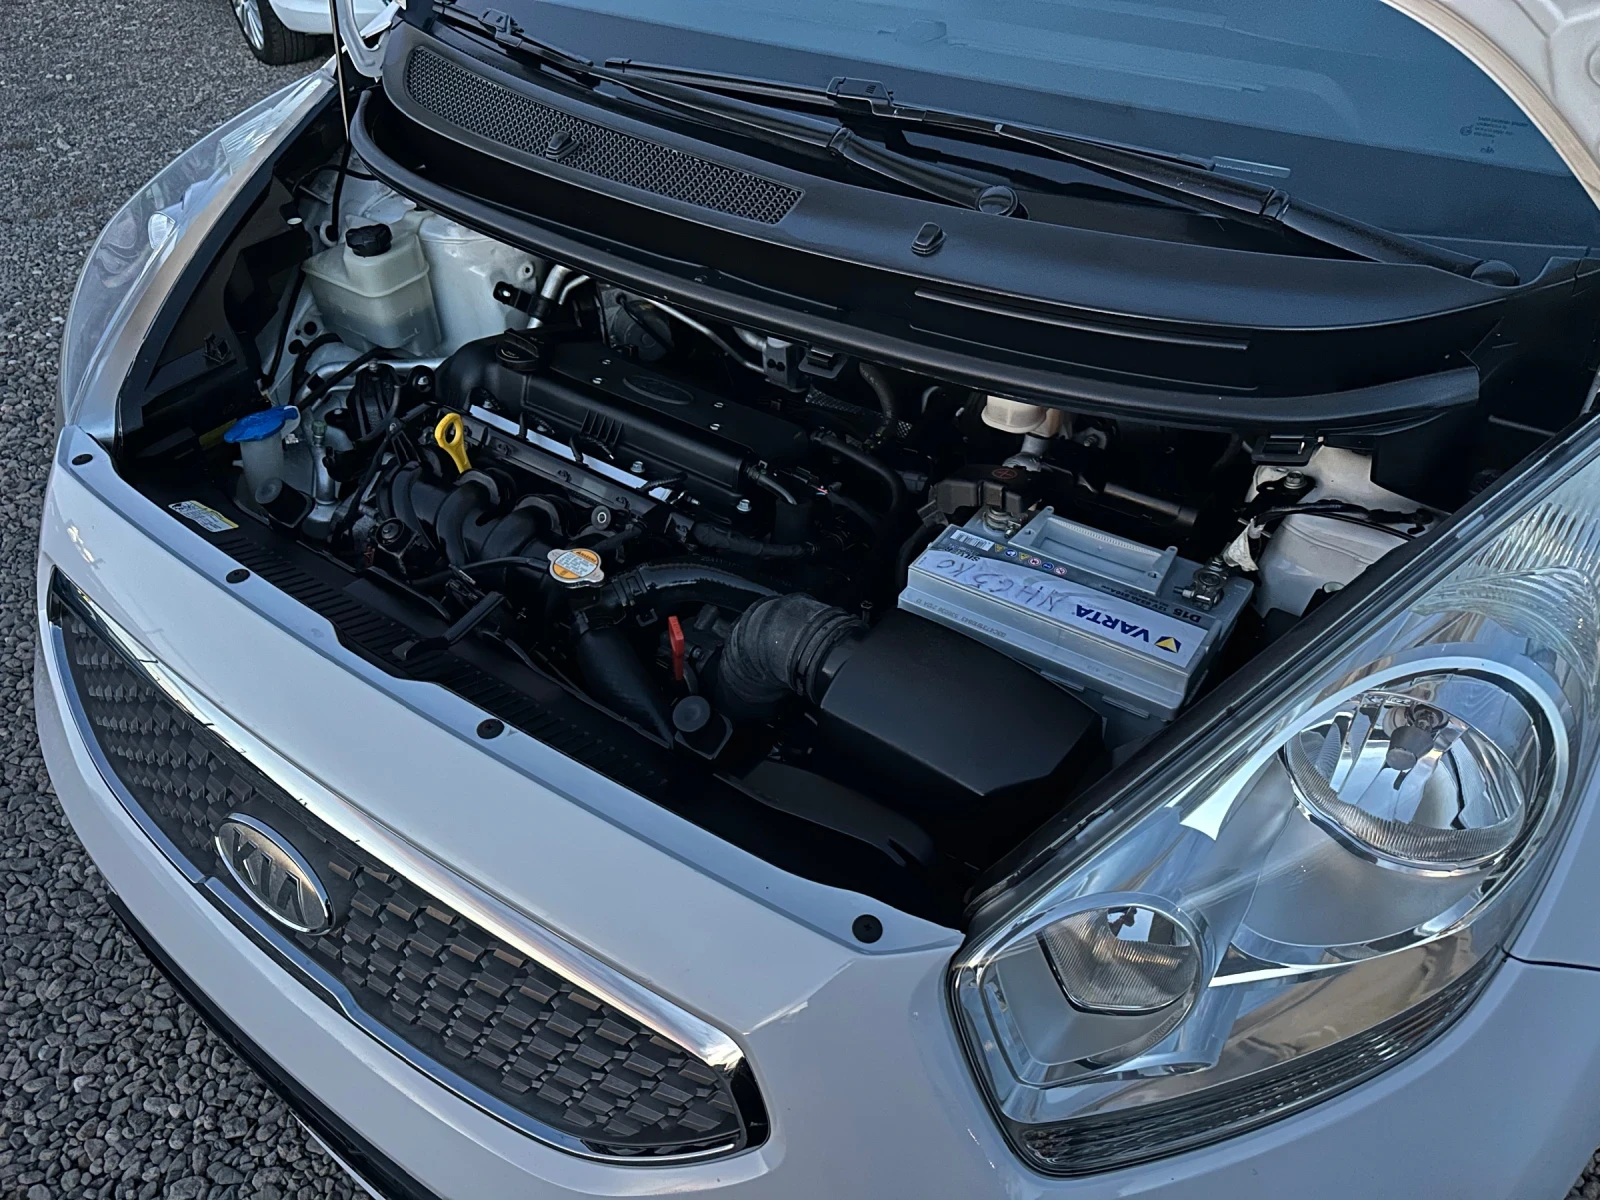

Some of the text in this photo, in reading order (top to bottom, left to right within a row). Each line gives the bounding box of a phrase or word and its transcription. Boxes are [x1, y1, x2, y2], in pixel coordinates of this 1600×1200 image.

[1075, 604, 1149, 643] VARTA
[1173, 608, 1203, 623] D15
[233, 826, 308, 926] KIA
